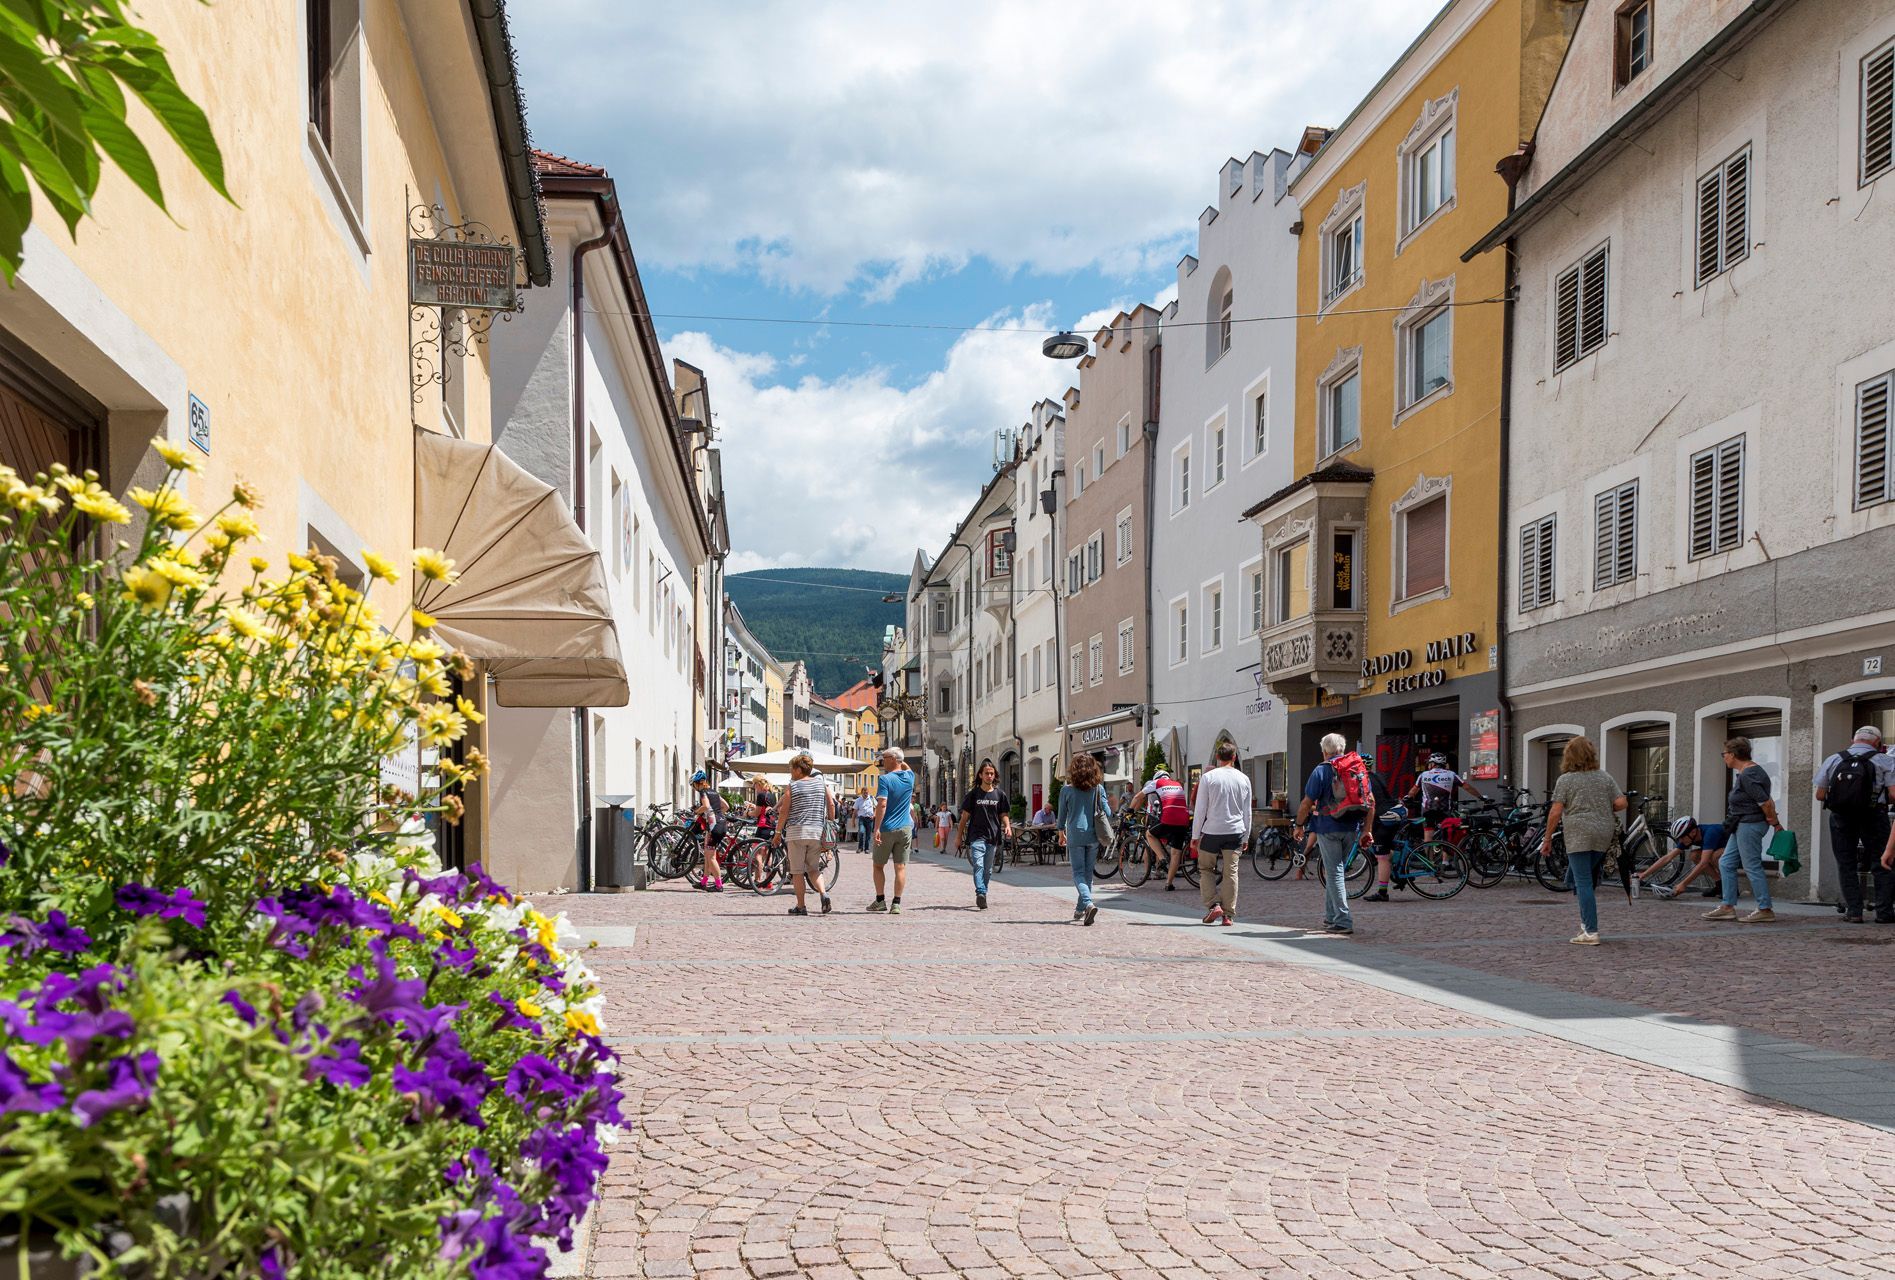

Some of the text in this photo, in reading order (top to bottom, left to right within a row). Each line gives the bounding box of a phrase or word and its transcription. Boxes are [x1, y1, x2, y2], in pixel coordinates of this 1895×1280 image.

[416, 245, 511, 268] DE CILLIA ROMANO
[417, 264, 510, 289] FEINSCHLEIFEREI
[437, 284, 489, 304] ARROTINO
[1361, 632, 1477, 678] RADIO MAIR
[1866, 659, 1879, 670] 72
[1385, 668, 1447, 695] ELECTRO
